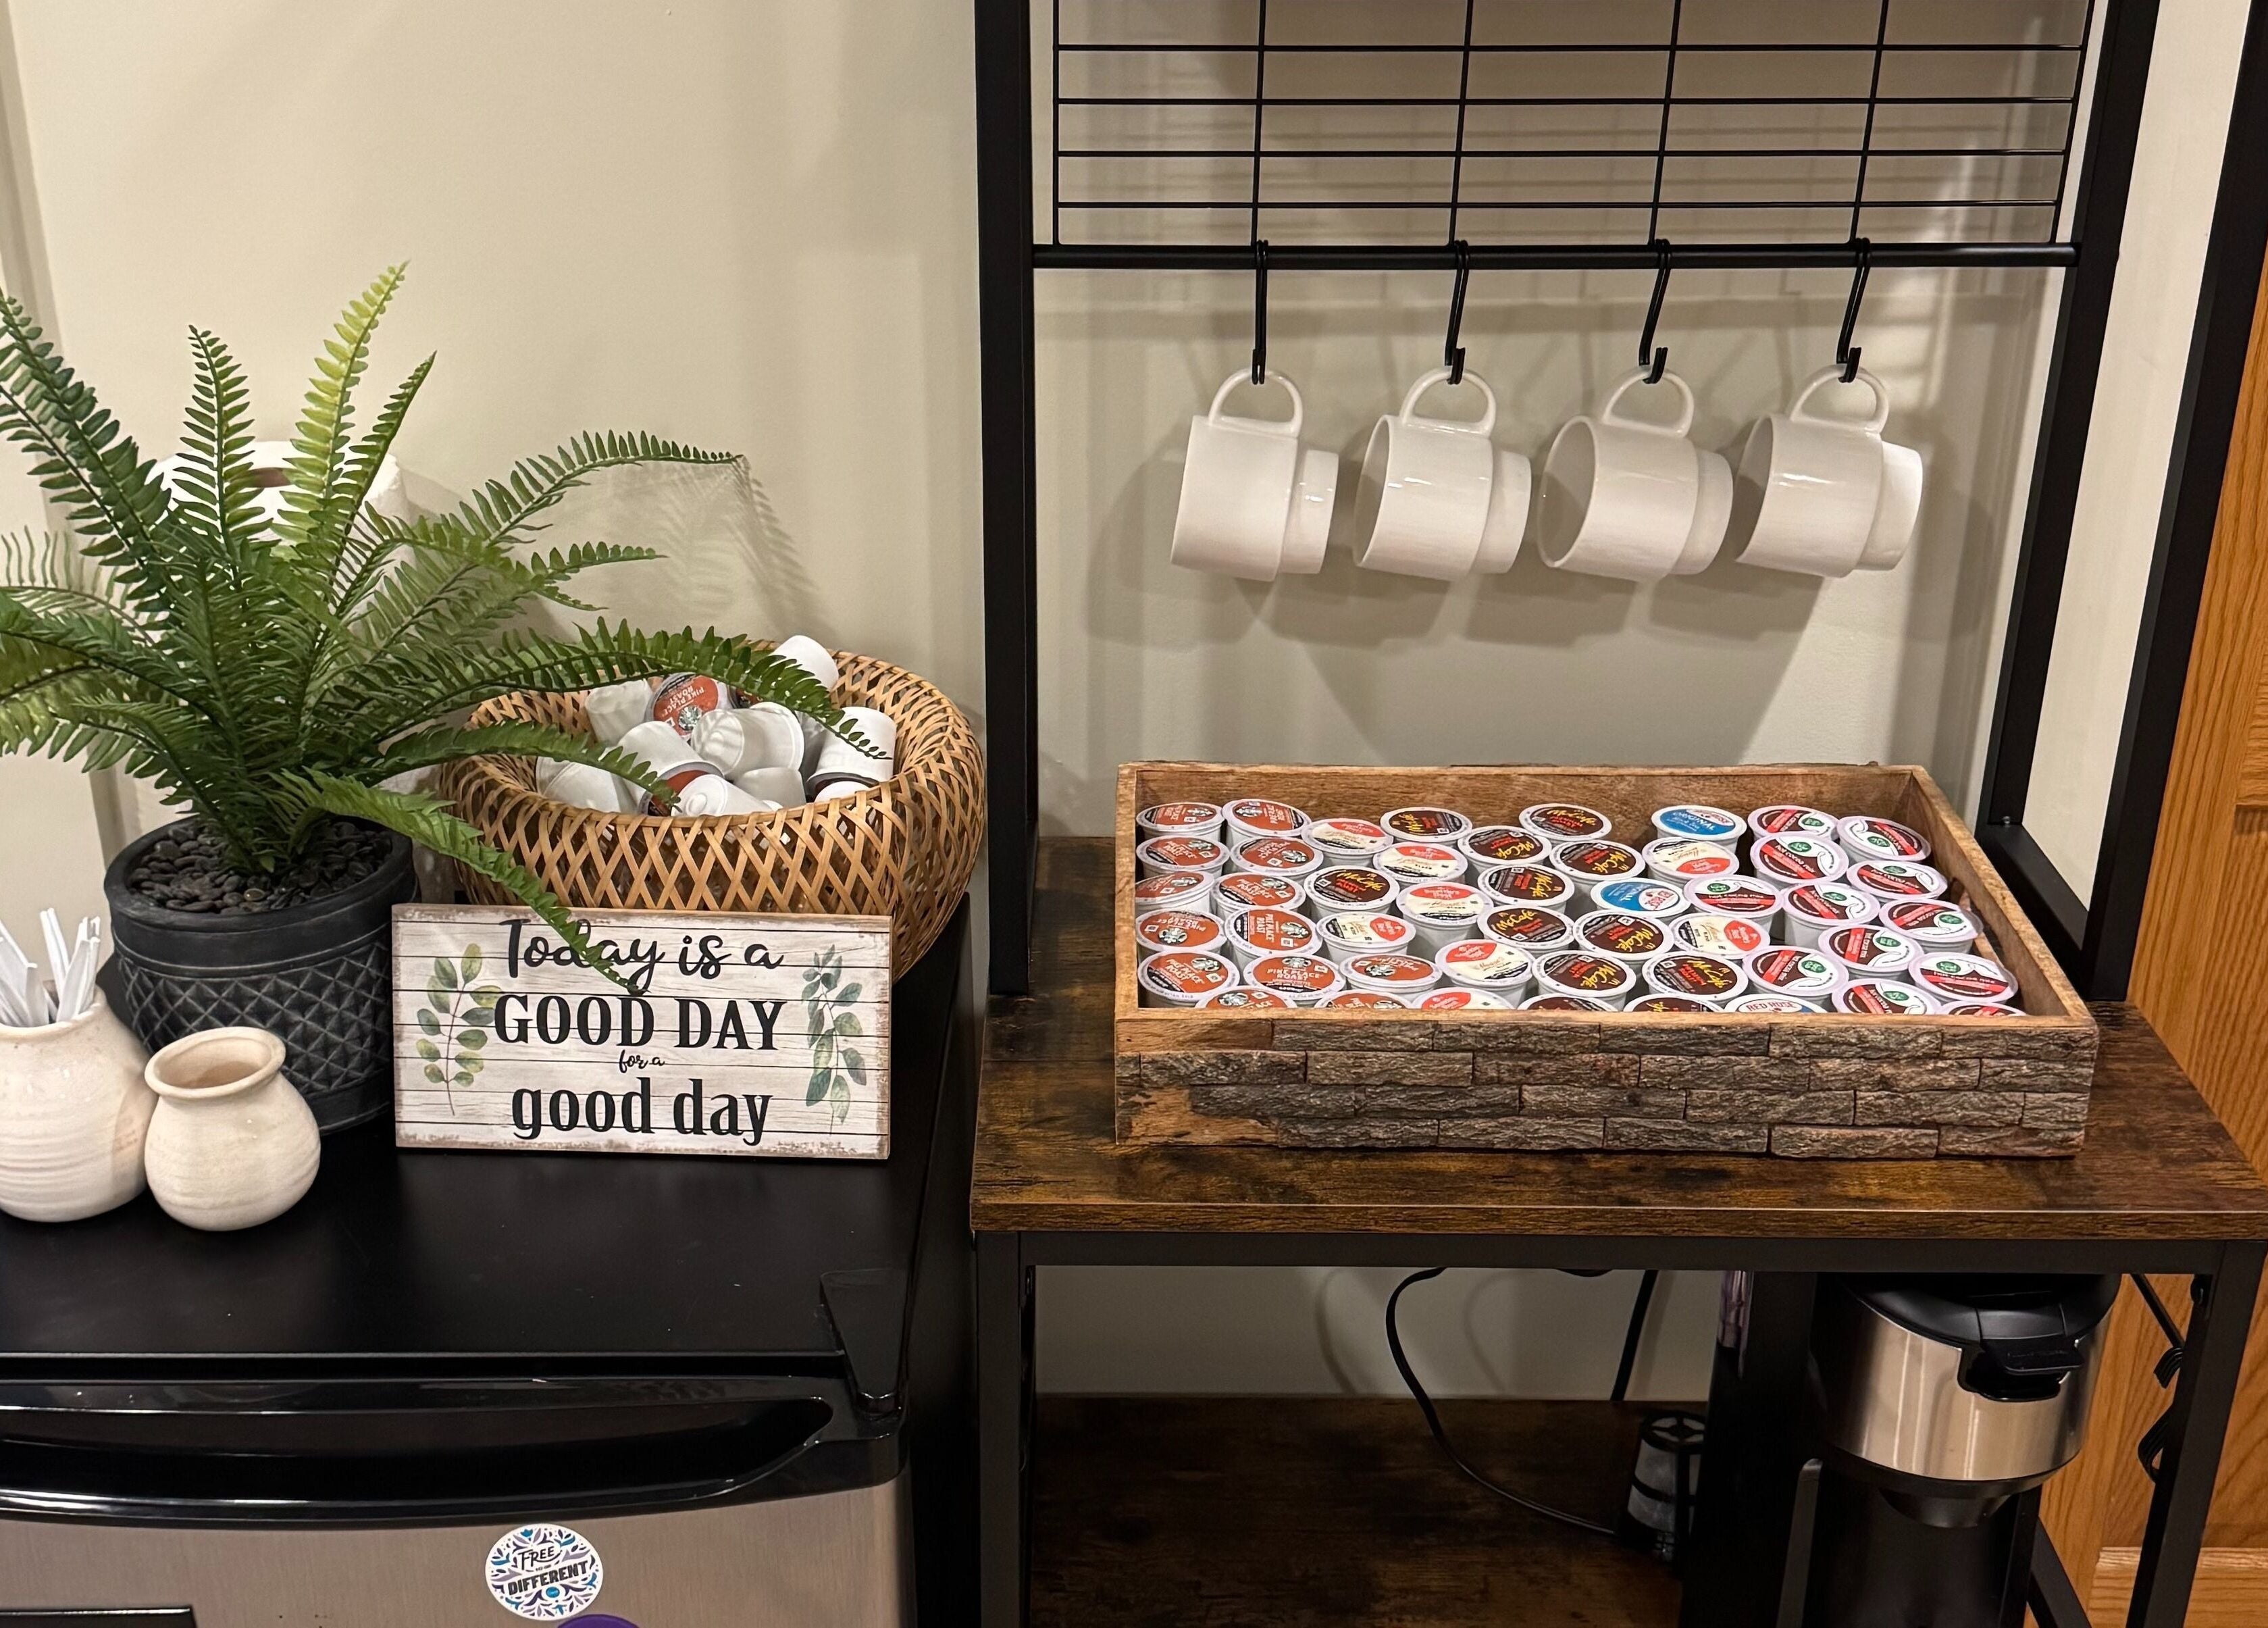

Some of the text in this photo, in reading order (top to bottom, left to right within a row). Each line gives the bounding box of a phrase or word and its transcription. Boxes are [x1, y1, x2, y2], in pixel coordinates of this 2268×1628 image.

[664, 686, 704, 715] PIKE PLACE
[669, 686, 694, 705] ROAST
[1496, 909, 1536, 931] McCafé
[1615, 928, 1654, 952] McCafé
[498, 918, 785, 995] Today is a
[1291, 968, 1321, 978] PLACE
[1746, 1002, 1768, 1011] RED
[494, 994, 788, 1050] GOOD DAY
[618, 1049, 666, 1073] for a
[511, 1077, 773, 1146] good day
[517, 1546, 558, 1571] FREE
[507, 1560, 588, 1596] DIFFERENT
